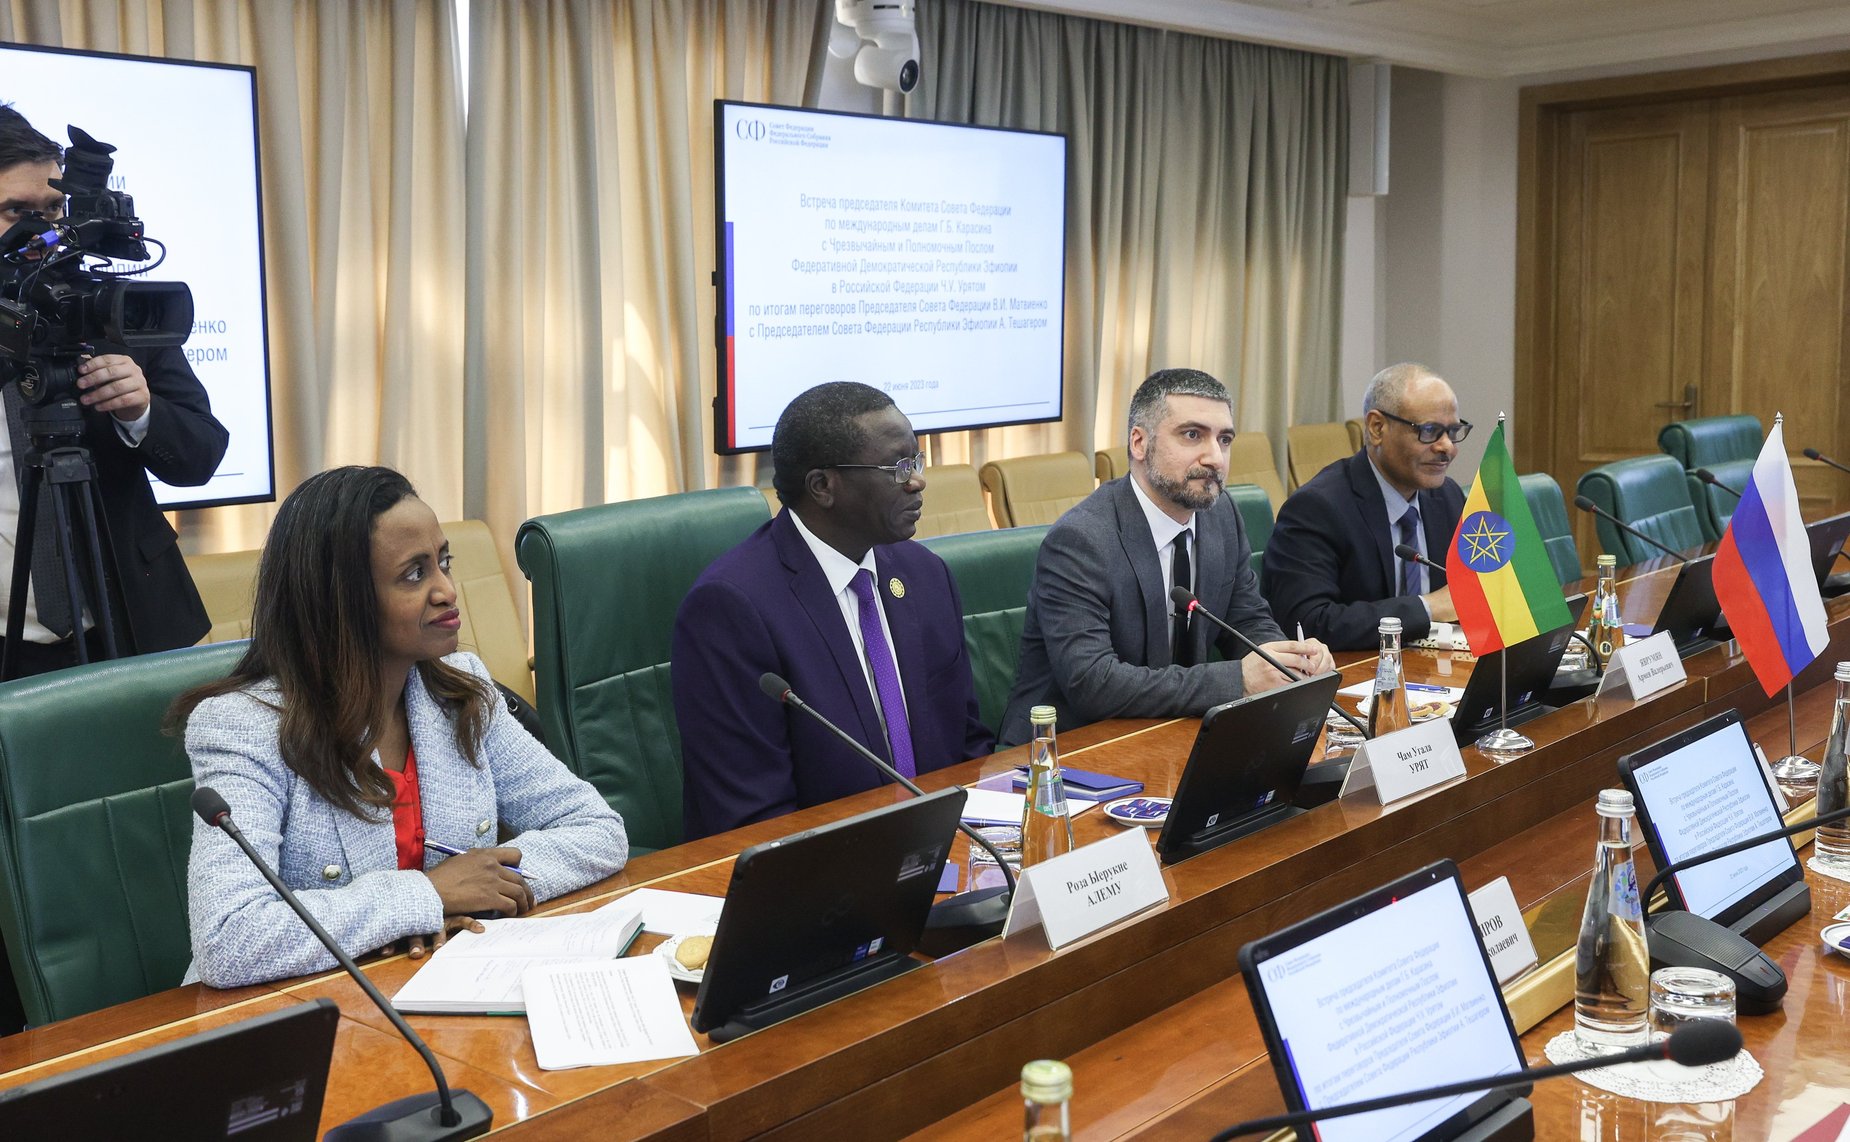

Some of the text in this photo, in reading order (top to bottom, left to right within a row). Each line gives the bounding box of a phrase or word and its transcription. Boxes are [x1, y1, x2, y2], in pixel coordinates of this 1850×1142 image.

[736, 118, 766, 141] СФ
[800, 193, 1012, 217] Встреча председателя Комитета Совета Федерации
[824, 218, 836, 230] по
[838, 219, 911, 234] международным
[912, 221, 938, 234] делам
[956, 220, 992, 236] Карасина
[821, 237, 995, 254] с Чрезвычайным и Полномочным Послом
[791, 258, 1018, 275] Федеративной Демократической Республики Эфиопии
[831, 282, 837, 293] в
[839, 279, 891, 293] Российской
[892, 280, 939, 295] Федерации
[957, 279, 986, 294] Урятом
[749, 304, 760, 316] по
[763, 304, 797, 316] итогам
[799, 303, 856, 317] переговоров
[858, 299, 917, 315] Председателя
[919, 299, 946, 313] Совета
[948, 299, 991, 314] Федерации
[1009, 297, 1048, 311] Матвиенко
[749, 326, 755, 338] с
[757, 323, 830, 340] Председателем
[831, 321, 862, 336] Совета
[864, 320, 911, 336] Федерации
[913, 317, 960, 335] Республики
[962, 318, 998, 331] Эфиопии
[1408, 758, 1429, 774] УРЯТ
[1066, 879, 1089, 894] Роза
[1087, 880, 1122, 907] АЛЕМУ
